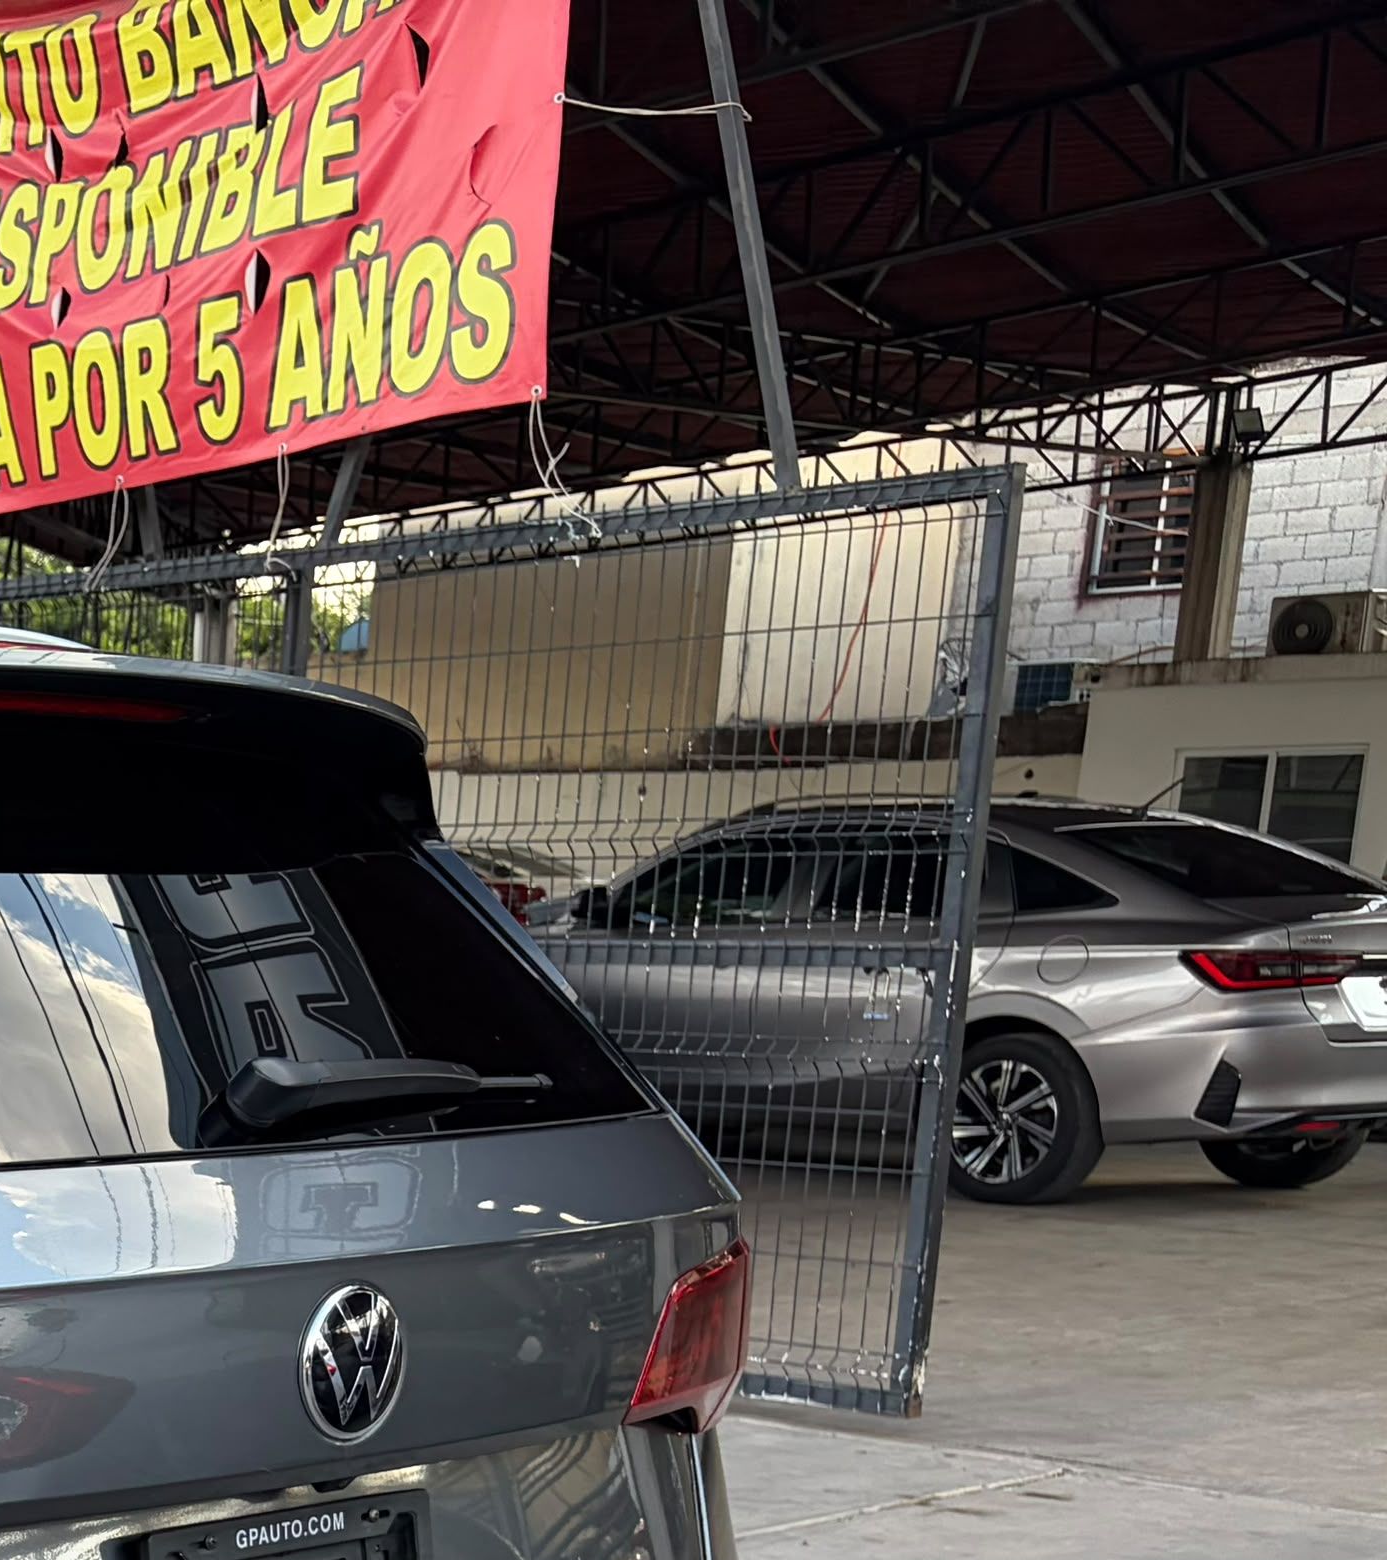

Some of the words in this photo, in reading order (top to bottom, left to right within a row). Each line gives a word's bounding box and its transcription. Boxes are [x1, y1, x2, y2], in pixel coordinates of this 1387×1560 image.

[116, 0, 399, 116] BAN
[31, 319, 179, 479] POR
[198, 297, 243, 443] 5
[269, 222, 515, 430] AÑOS
[235, 1511, 345, 1549] GPAUTO.COM
